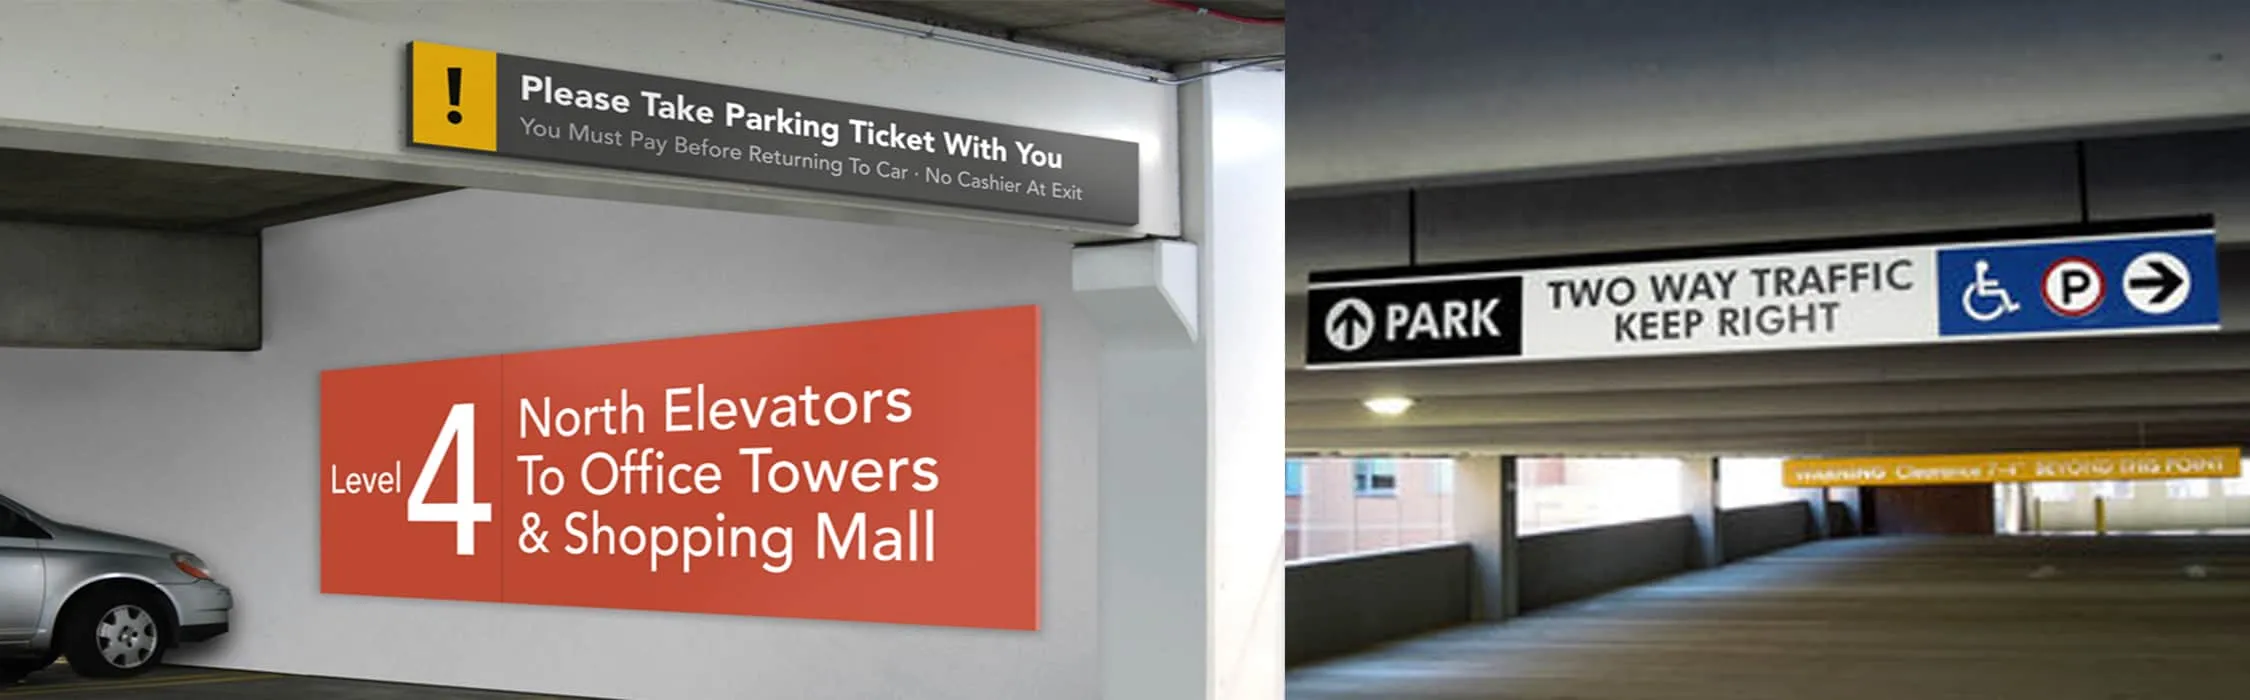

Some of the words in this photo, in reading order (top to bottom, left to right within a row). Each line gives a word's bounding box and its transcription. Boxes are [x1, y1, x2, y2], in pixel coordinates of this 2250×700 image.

[519, 74, 632, 114] Please
[640, 90, 715, 125] Take
[725, 101, 840, 147] Parking
[848, 118, 936, 154] Ticket
[942, 130, 1008, 164] With
[1013, 140, 1063, 170] You
[519, 116, 562, 140] You
[569, 123, 623, 147] Must
[631, 130, 668, 156] Pay
[675, 135, 742, 161] Before
[749, 144, 843, 177] Returning
[847, 156, 872, 175] To
[876, 160, 909, 180] Car
[925, 166, 953, 185] No
[957, 171, 1023, 194] Cashier
[1025, 178, 1047, 197] At
[1051, 182, 1084, 201] Exit
[1547, 272, 1637, 310] TWO
[1649, 269, 1739, 303] WAY
[1749, 259, 1914, 297] TRAFFIC
[2060, 268, 2092, 306] P
[1385, 297, 1502, 342] PARK
[1614, 308, 1705, 343] KEEP
[1719, 301, 1841, 338] RIGHT
[519, 388, 646, 439] North
[664, 382, 914, 434] Elevators
[330, 460, 402, 495] Level
[407, 402, 493, 557] 4
[516, 454, 566, 497] To
[580, 447, 723, 497] Office
[738, 446, 940, 495] Towers
[517, 511, 551, 555] &
[563, 509, 795, 574] Shopping
[816, 507, 936, 563] Mall
